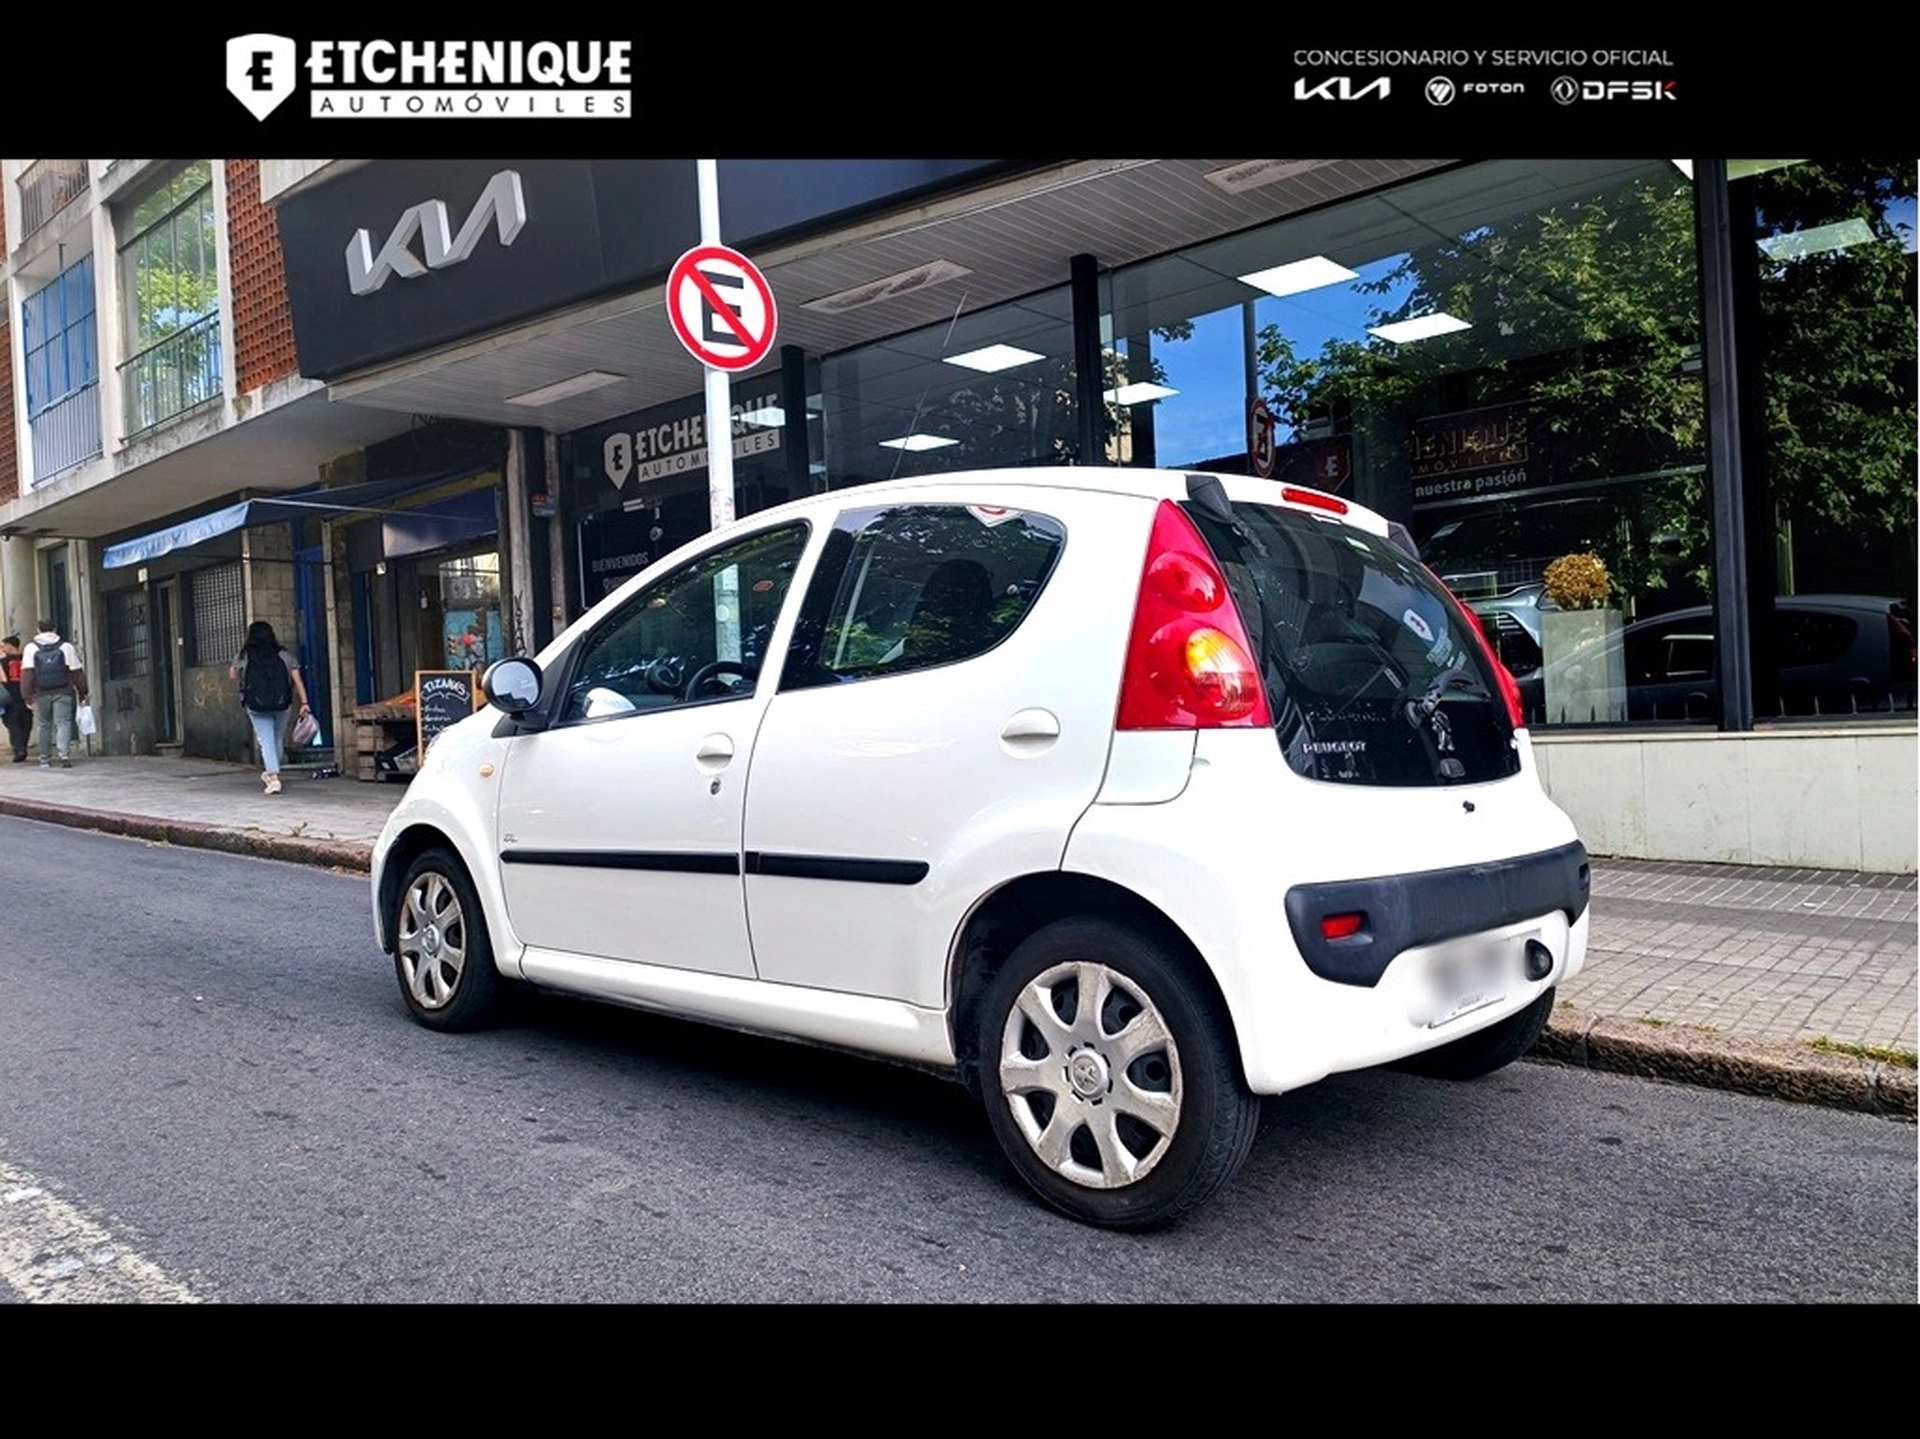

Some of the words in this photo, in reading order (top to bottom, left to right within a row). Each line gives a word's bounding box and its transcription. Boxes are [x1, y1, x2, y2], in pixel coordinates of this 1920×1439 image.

[345, 169, 527, 295] KIA
[700, 269, 748, 347] E
[1414, 477, 1472, 498] nuestra
[1475, 468, 1528, 491] pasión
[591, 552, 649, 573] BIENVENIDOS
[1302, 740, 1366, 754] PEUGEOT
